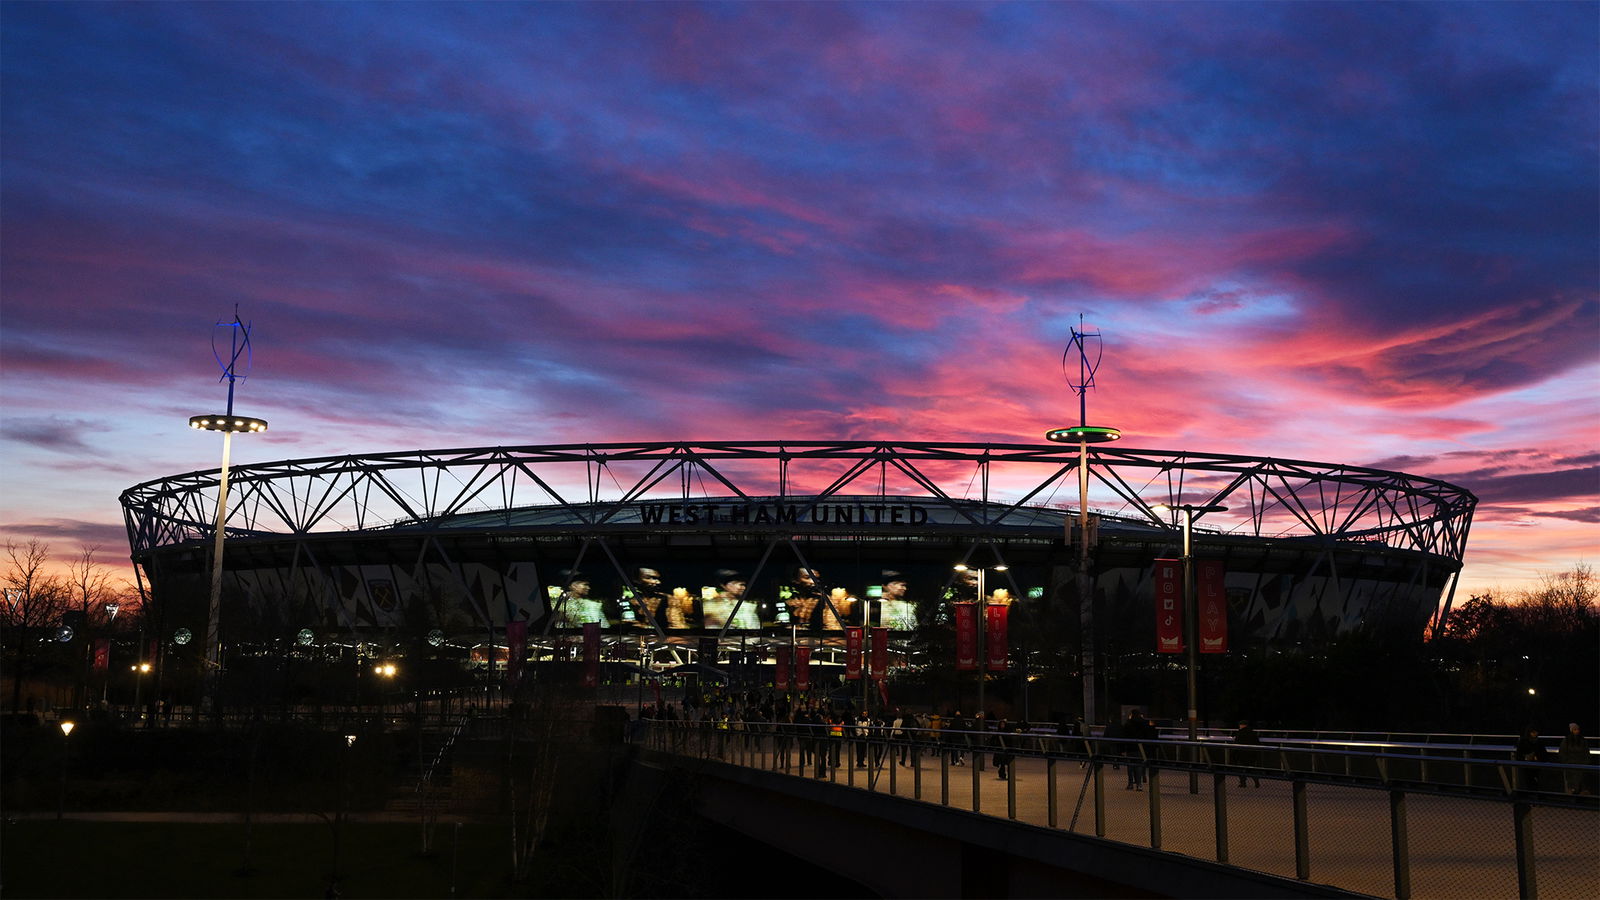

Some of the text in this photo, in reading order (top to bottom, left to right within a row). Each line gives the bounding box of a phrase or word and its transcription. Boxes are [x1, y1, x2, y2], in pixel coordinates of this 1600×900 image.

[640, 504, 928, 525] WEST HAM UNITED
[1205, 566, 1218, 632] PLAY
